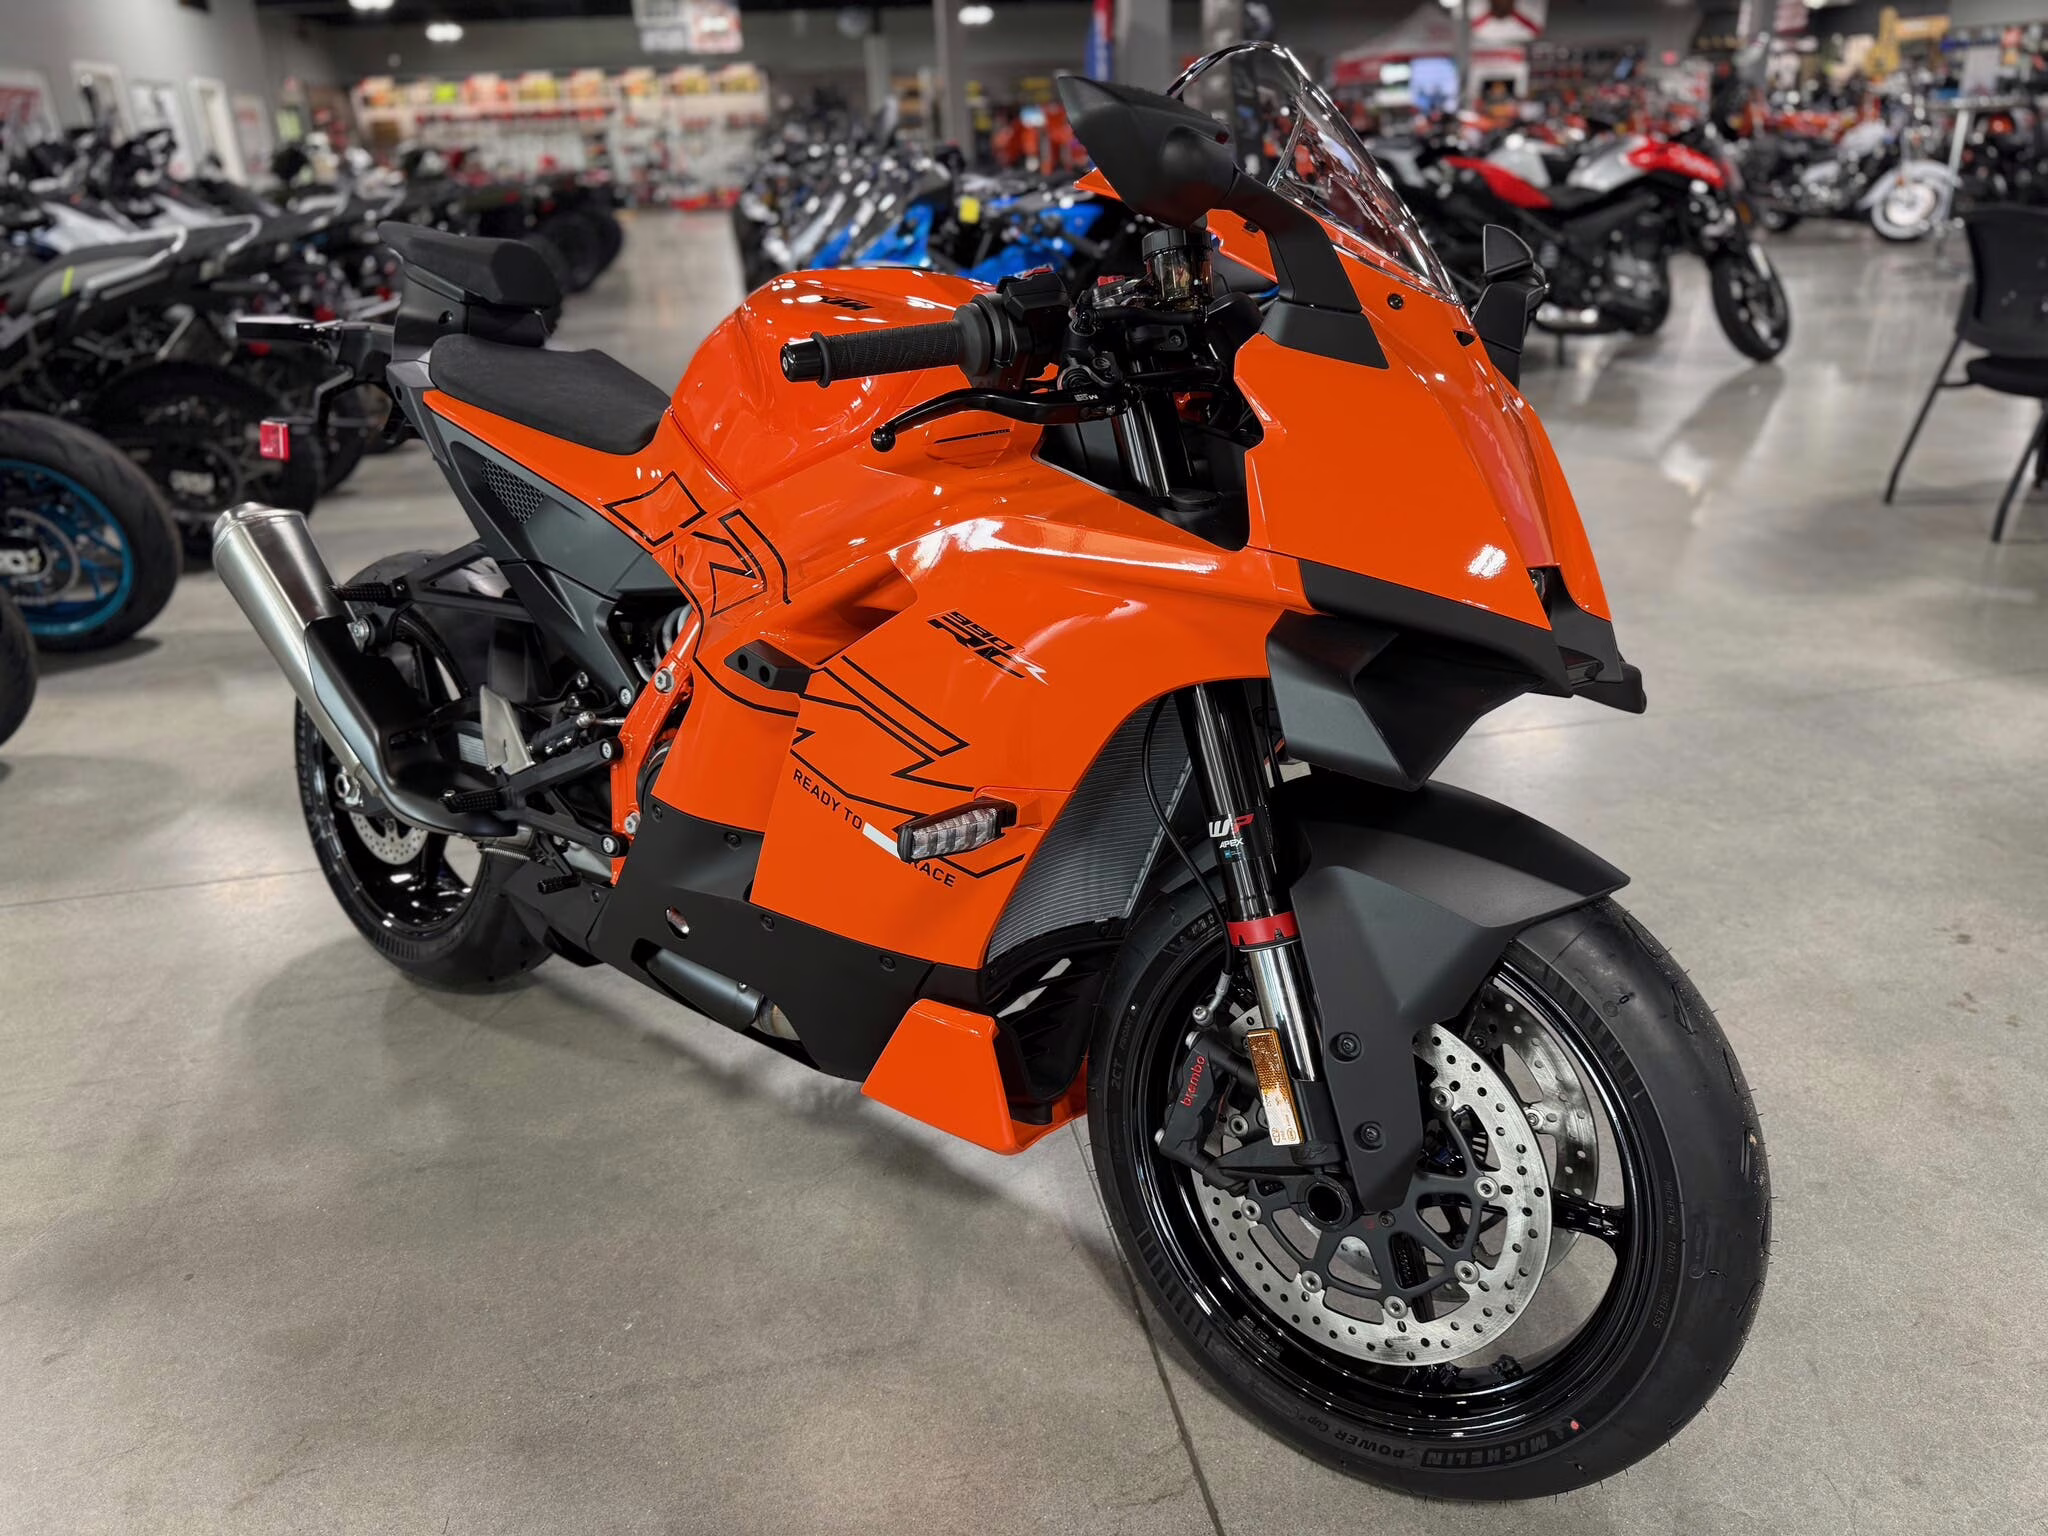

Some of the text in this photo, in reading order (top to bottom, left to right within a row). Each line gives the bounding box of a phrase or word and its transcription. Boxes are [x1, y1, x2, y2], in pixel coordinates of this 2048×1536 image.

[793, 768, 840, 812] READY
[845, 807, 863, 830] TO
[1209, 814, 1254, 837] WP
[1219, 838, 1244, 848] APEX
[1180, 1056, 1206, 1107] brembo
[1334, 1430, 1405, 1459] POWER
[1428, 1433, 1549, 1465] MICHELIN
